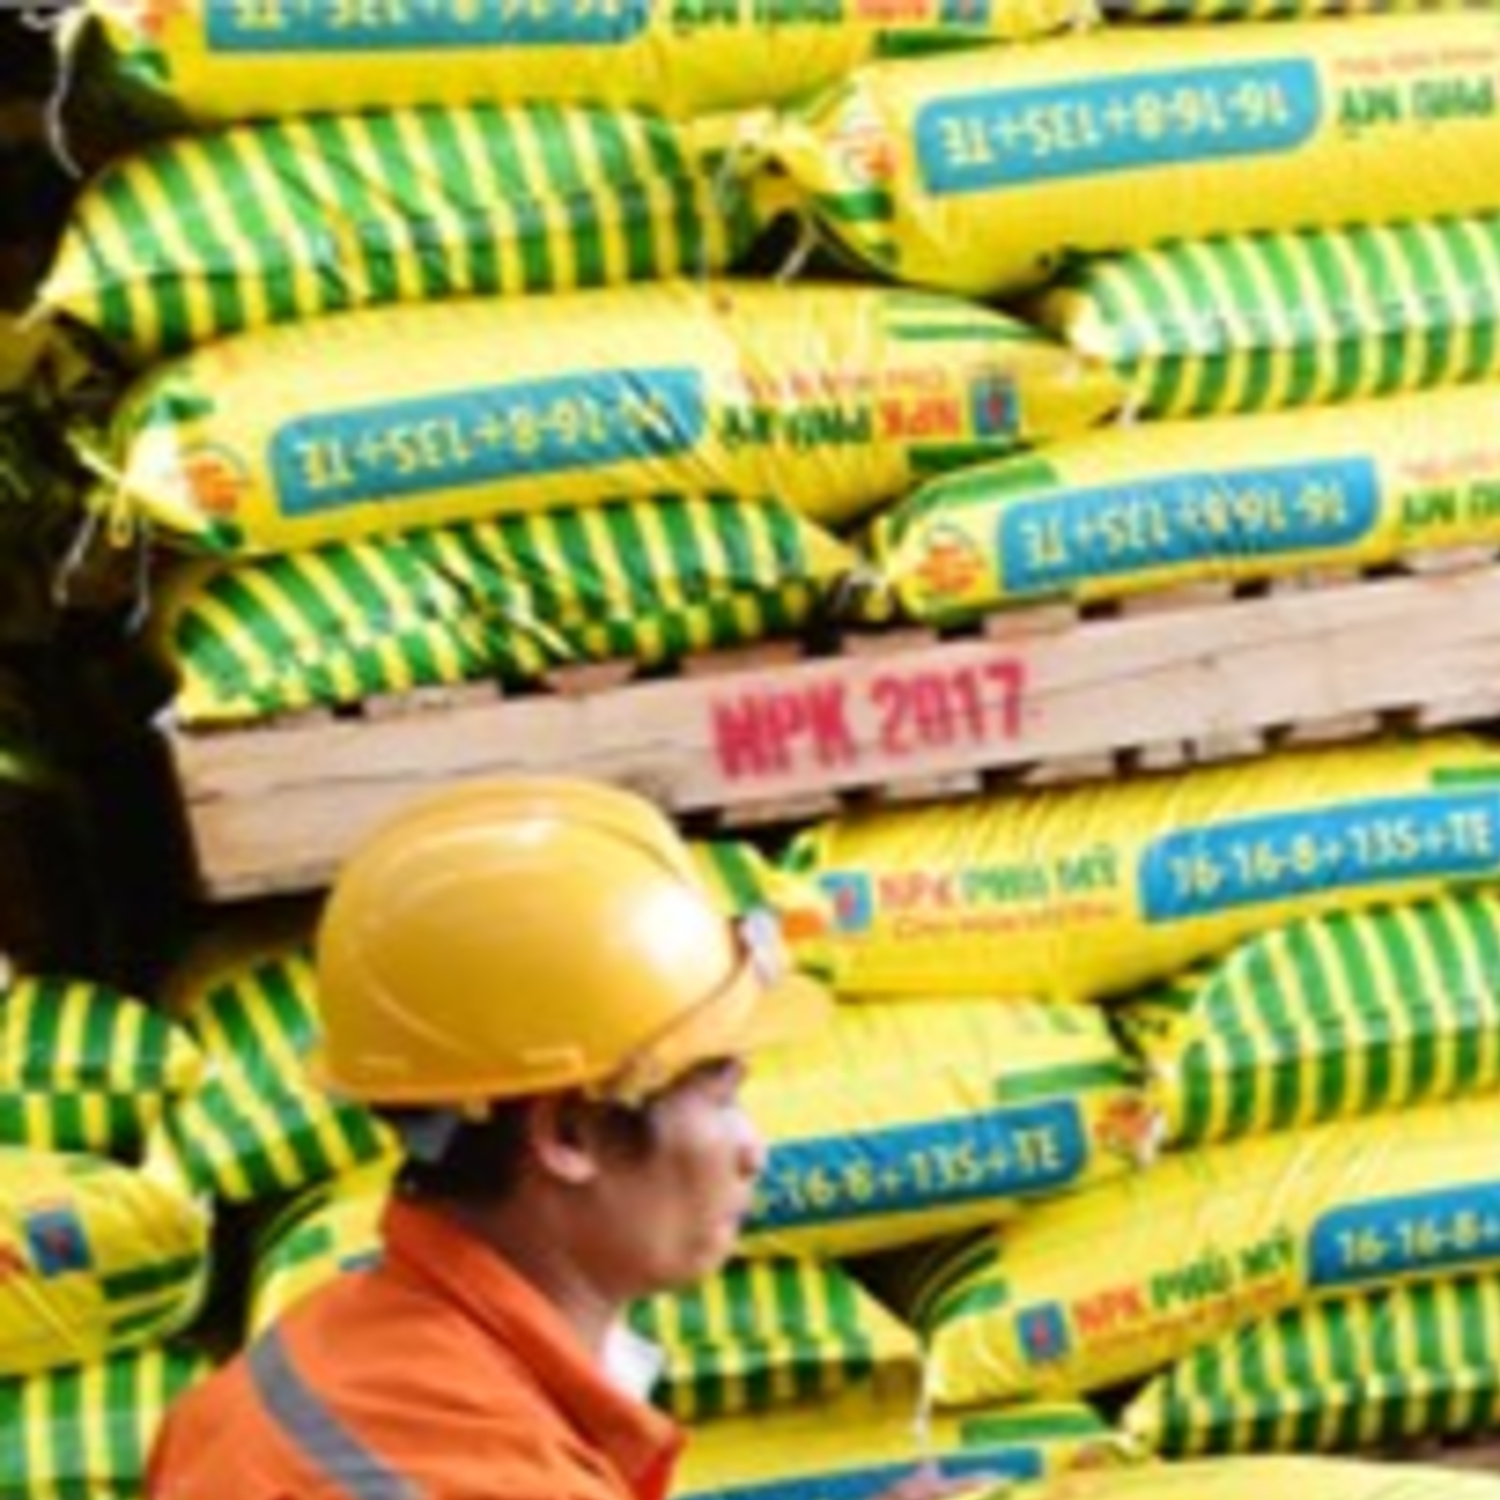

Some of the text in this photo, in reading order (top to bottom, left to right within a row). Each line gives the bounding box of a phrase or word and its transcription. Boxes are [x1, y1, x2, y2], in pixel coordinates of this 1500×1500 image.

[712, 660, 1028, 782] NPK 2017
[878, 868, 956, 910] NPK
[1166, 808, 1494, 897] 16-16-8+13S+TE
[1070, 1286, 1146, 1334] NPK
